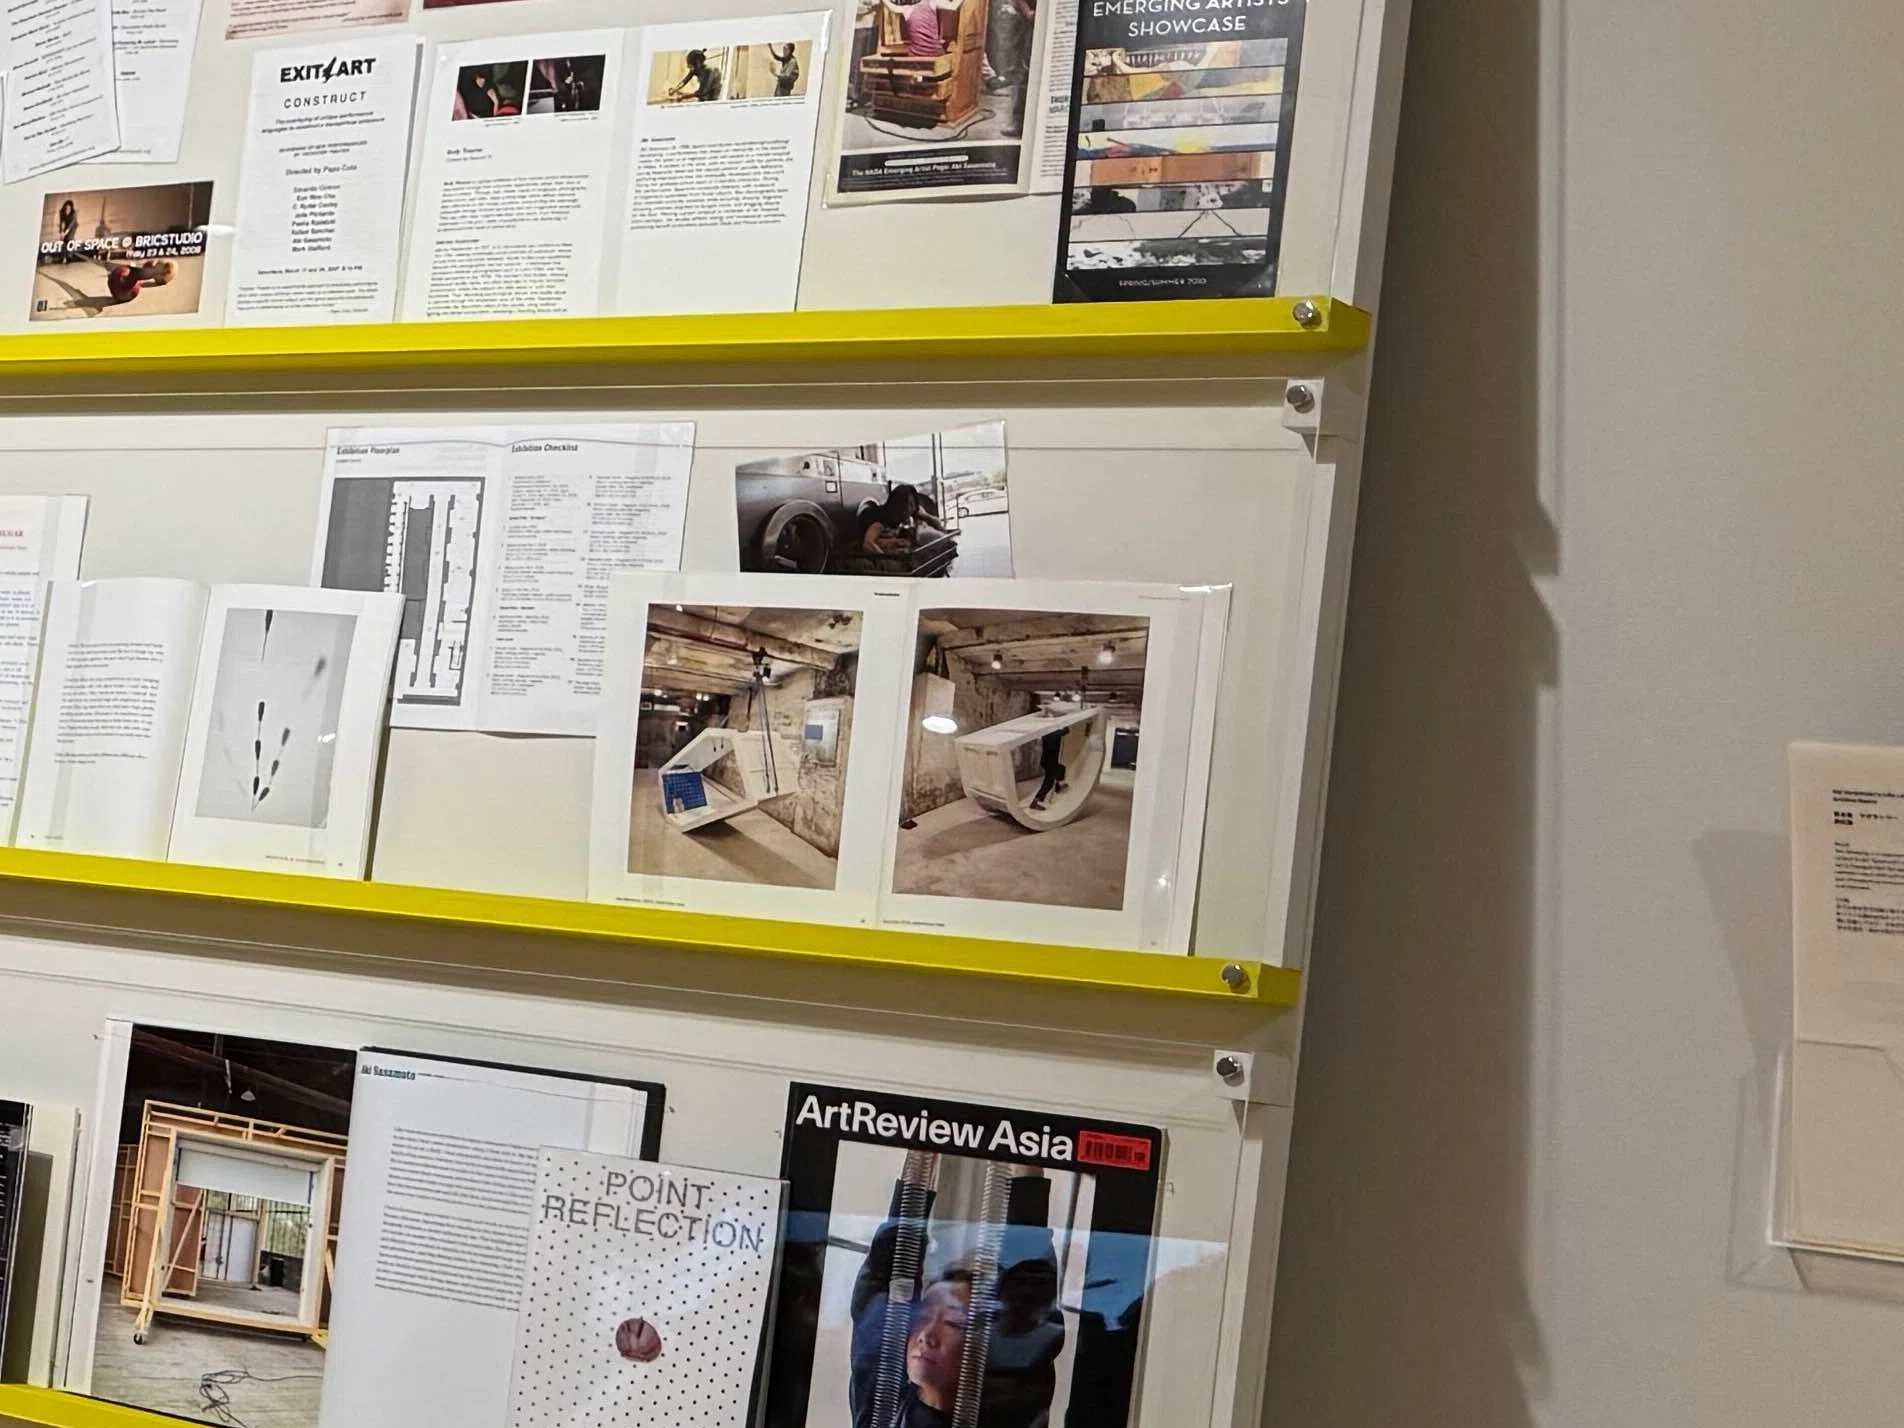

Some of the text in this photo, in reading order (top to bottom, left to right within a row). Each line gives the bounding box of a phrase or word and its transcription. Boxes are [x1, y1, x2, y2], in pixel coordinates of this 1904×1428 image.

[1128, 15, 1247, 38] SHOWCASE
[283, 90, 367, 109] CONSTRUCT
[285, 168, 312, 176] Directed
[41, 240, 64, 254] OUT
[66, 240, 82, 252] OF
[84, 236, 119, 251] SPACE
[135, 232, 203, 247] BRICSTUDIO
[336, 446, 369, 456] Exhibition
[511, 443, 578, 453] Exhibition Checklist
[373, 1065, 416, 1081] Sasamoto
[795, 1094, 985, 1148] ArtReview
[987, 1119, 1073, 1162] Asia
[605, 1171, 711, 1210] POINT
[543, 1194, 763, 1252] REFLECTION
